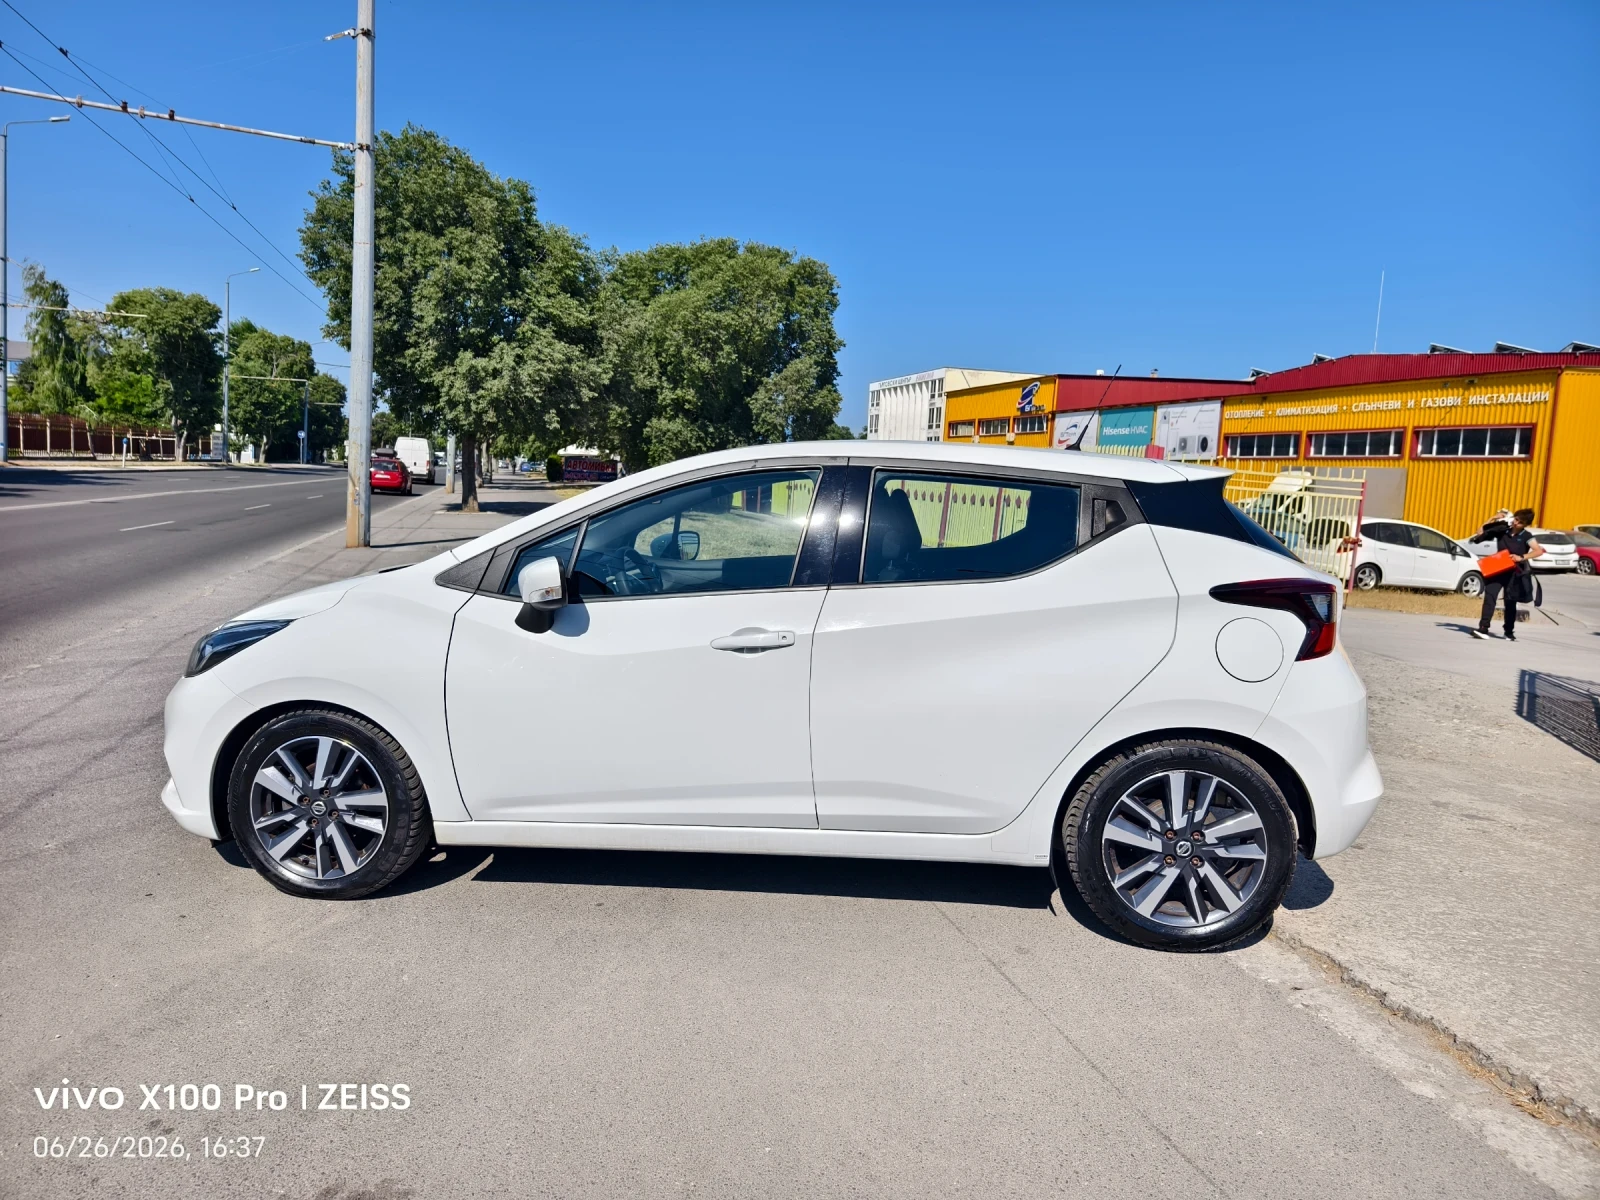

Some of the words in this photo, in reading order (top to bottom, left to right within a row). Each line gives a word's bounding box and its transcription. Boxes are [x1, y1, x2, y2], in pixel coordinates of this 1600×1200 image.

[1224, 408, 1265, 419] ОТОПЛЕНИЕ
[1275, 404, 1339, 416] КЛИМАТИЗАЦИЯ
[1351, 400, 1401, 413] СЛЪНЧЕВИ
[1407, 399, 1415, 409] И
[1420, 396, 1462, 408] ГАЗОВИ
[1468, 391, 1550, 405] ИНСТАЛАЦИИ
[1102, 426, 1130, 436] Hisense
[1130, 425, 1148, 434] HVAC
